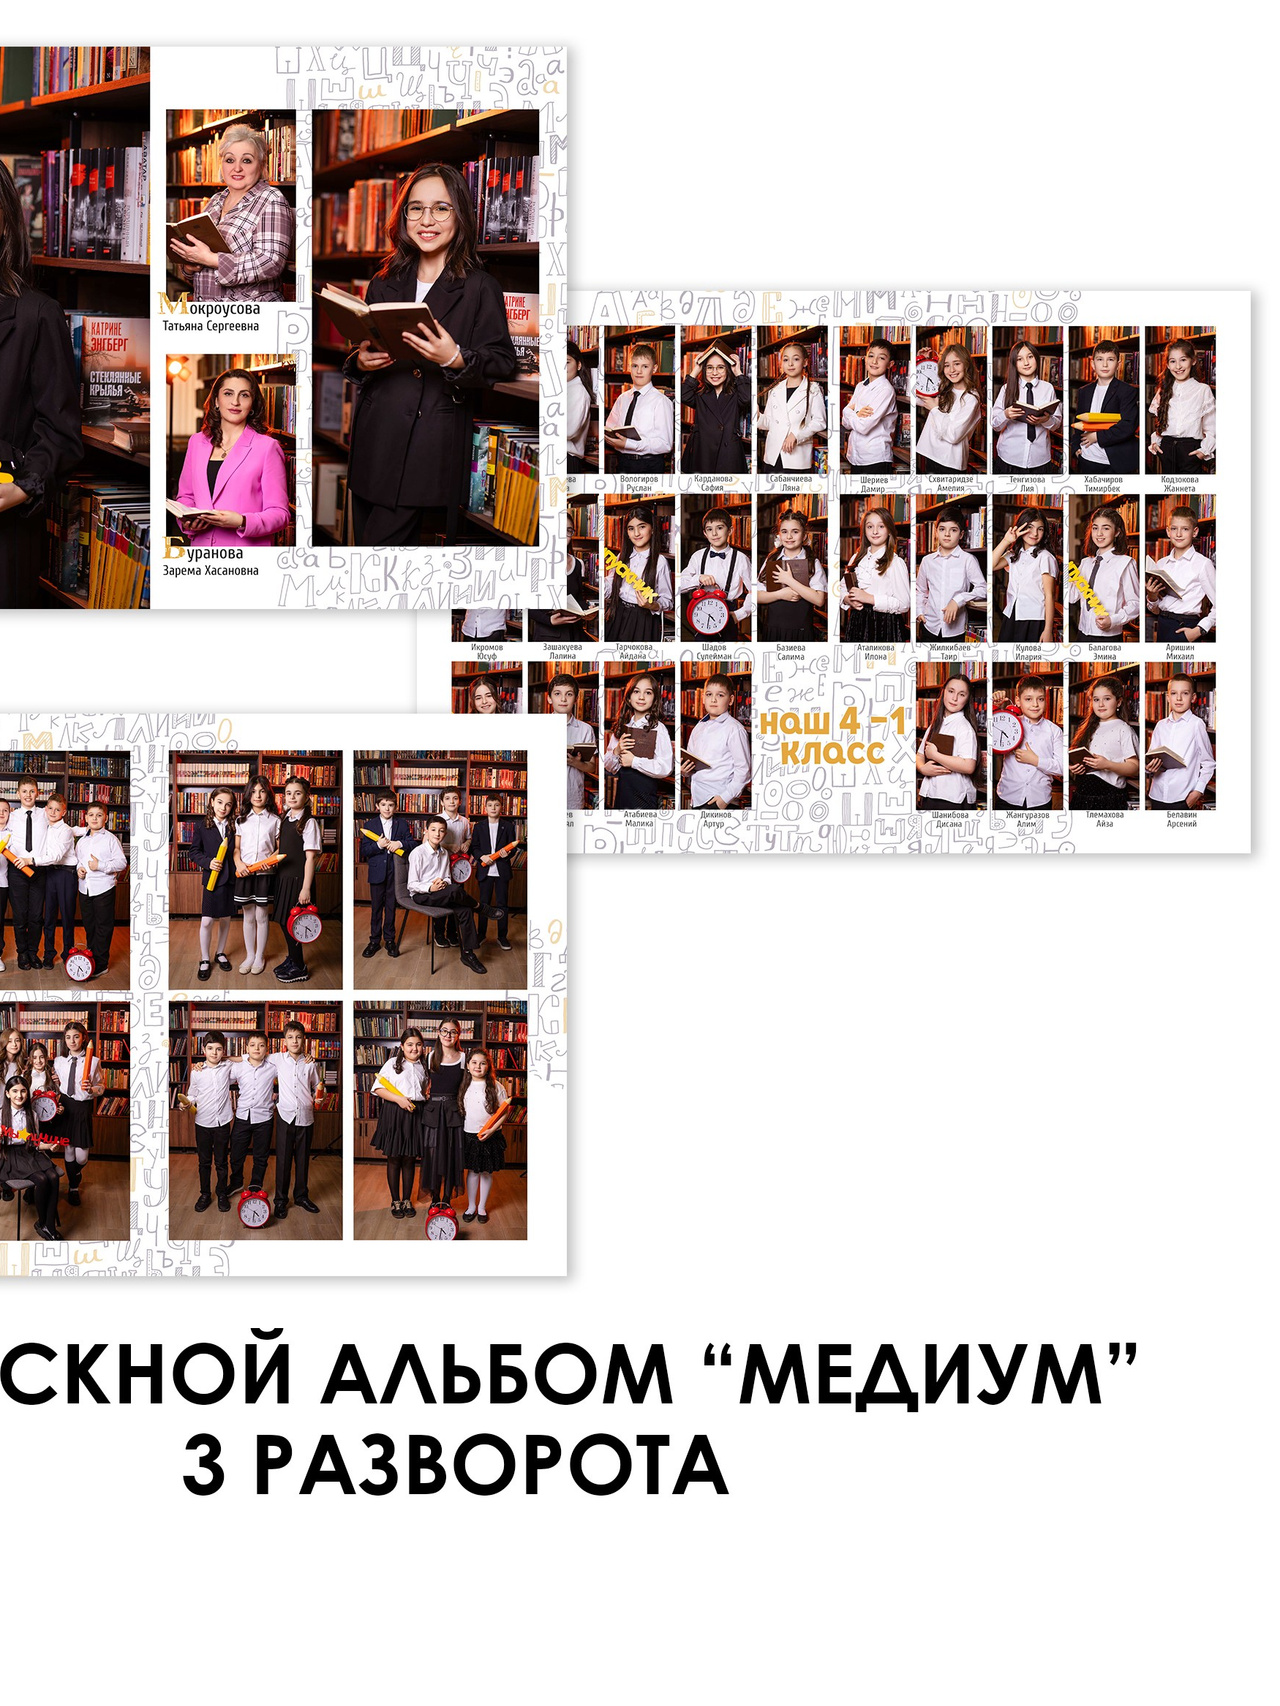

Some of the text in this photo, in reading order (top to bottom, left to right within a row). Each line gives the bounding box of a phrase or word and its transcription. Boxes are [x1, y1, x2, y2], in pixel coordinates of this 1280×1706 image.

[503, 296, 525, 307] АТРИНЕ
[505, 309, 530, 320] НГБЕРГ
[91, 322, 122, 336] КАТРИНЕ
[91, 337, 128, 351] ЭНГБЕРГ
[90, 371, 141, 384] СТЕКЛЯННЫЕ
[90, 384, 123, 397] КРЫЛЬЯ
